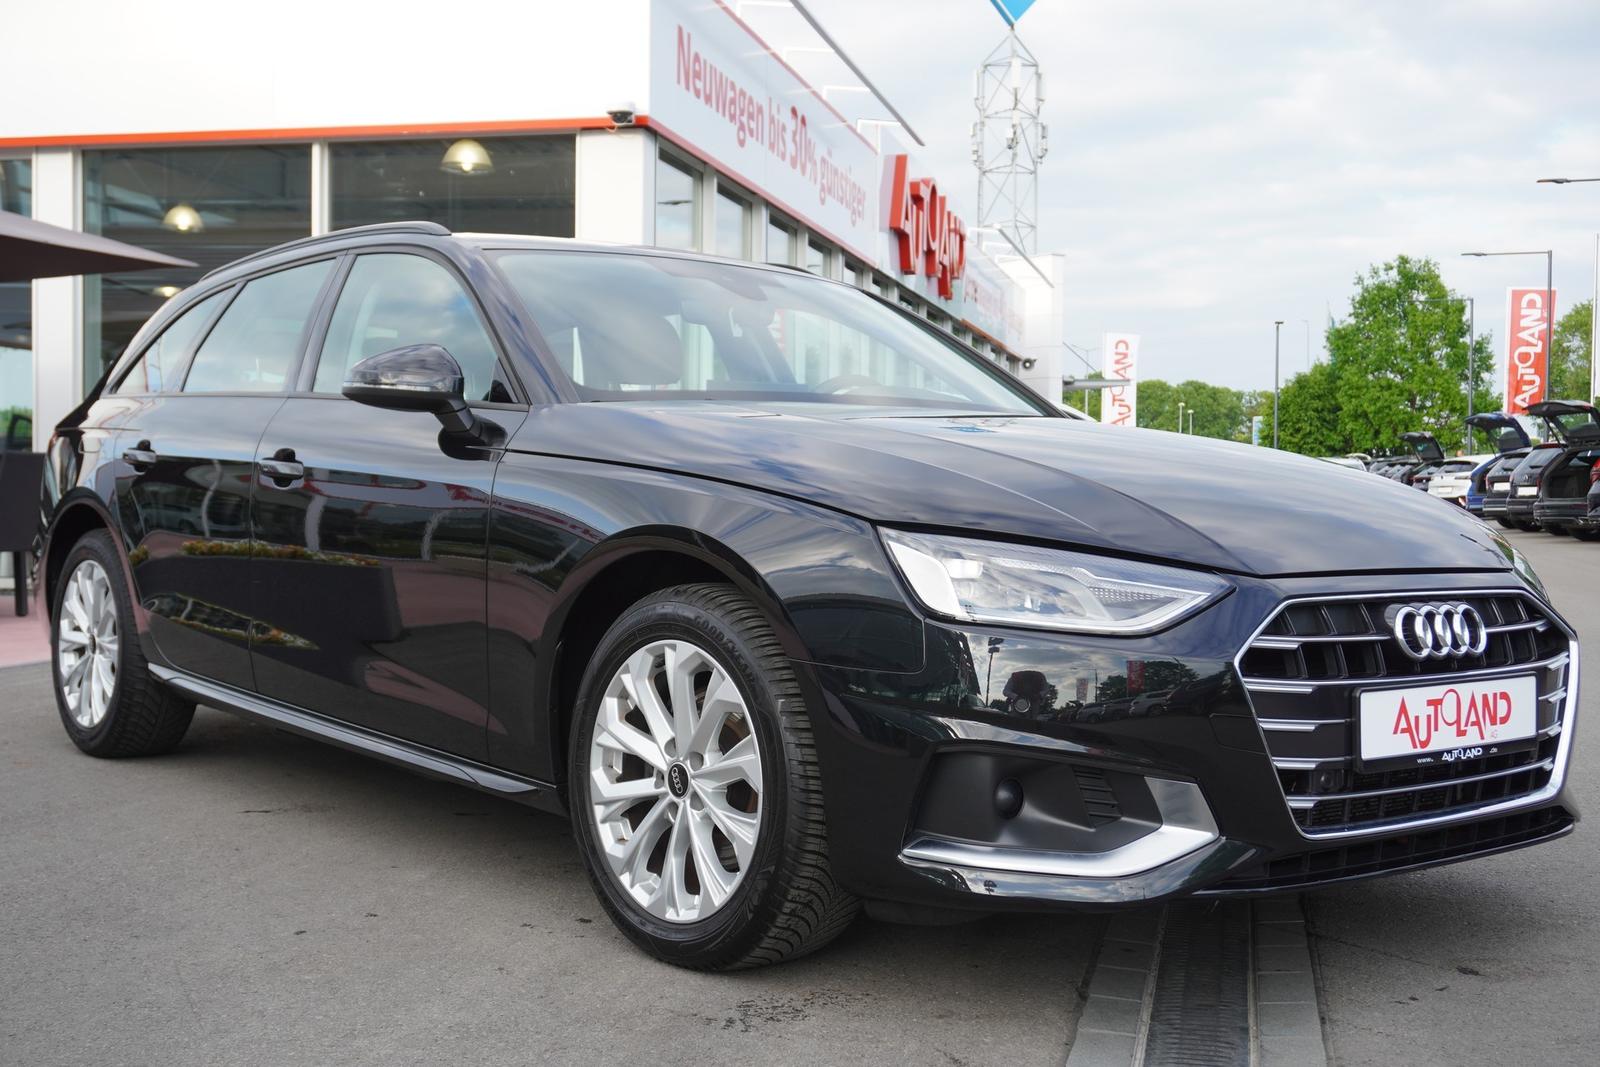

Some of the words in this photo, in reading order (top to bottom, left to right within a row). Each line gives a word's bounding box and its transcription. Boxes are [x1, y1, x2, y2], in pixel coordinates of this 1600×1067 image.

[677, 24, 764, 148] Neuwagen
[768, 97, 787, 161] bis
[790, 106, 817, 185] 30%
[819, 146, 866, 227] günstiger
[1513, 292, 1547, 409] AUTOLAND
[1393, 688, 1512, 749] AUTOLAND
[1441, 747, 1483, 762] AUTOLAND
